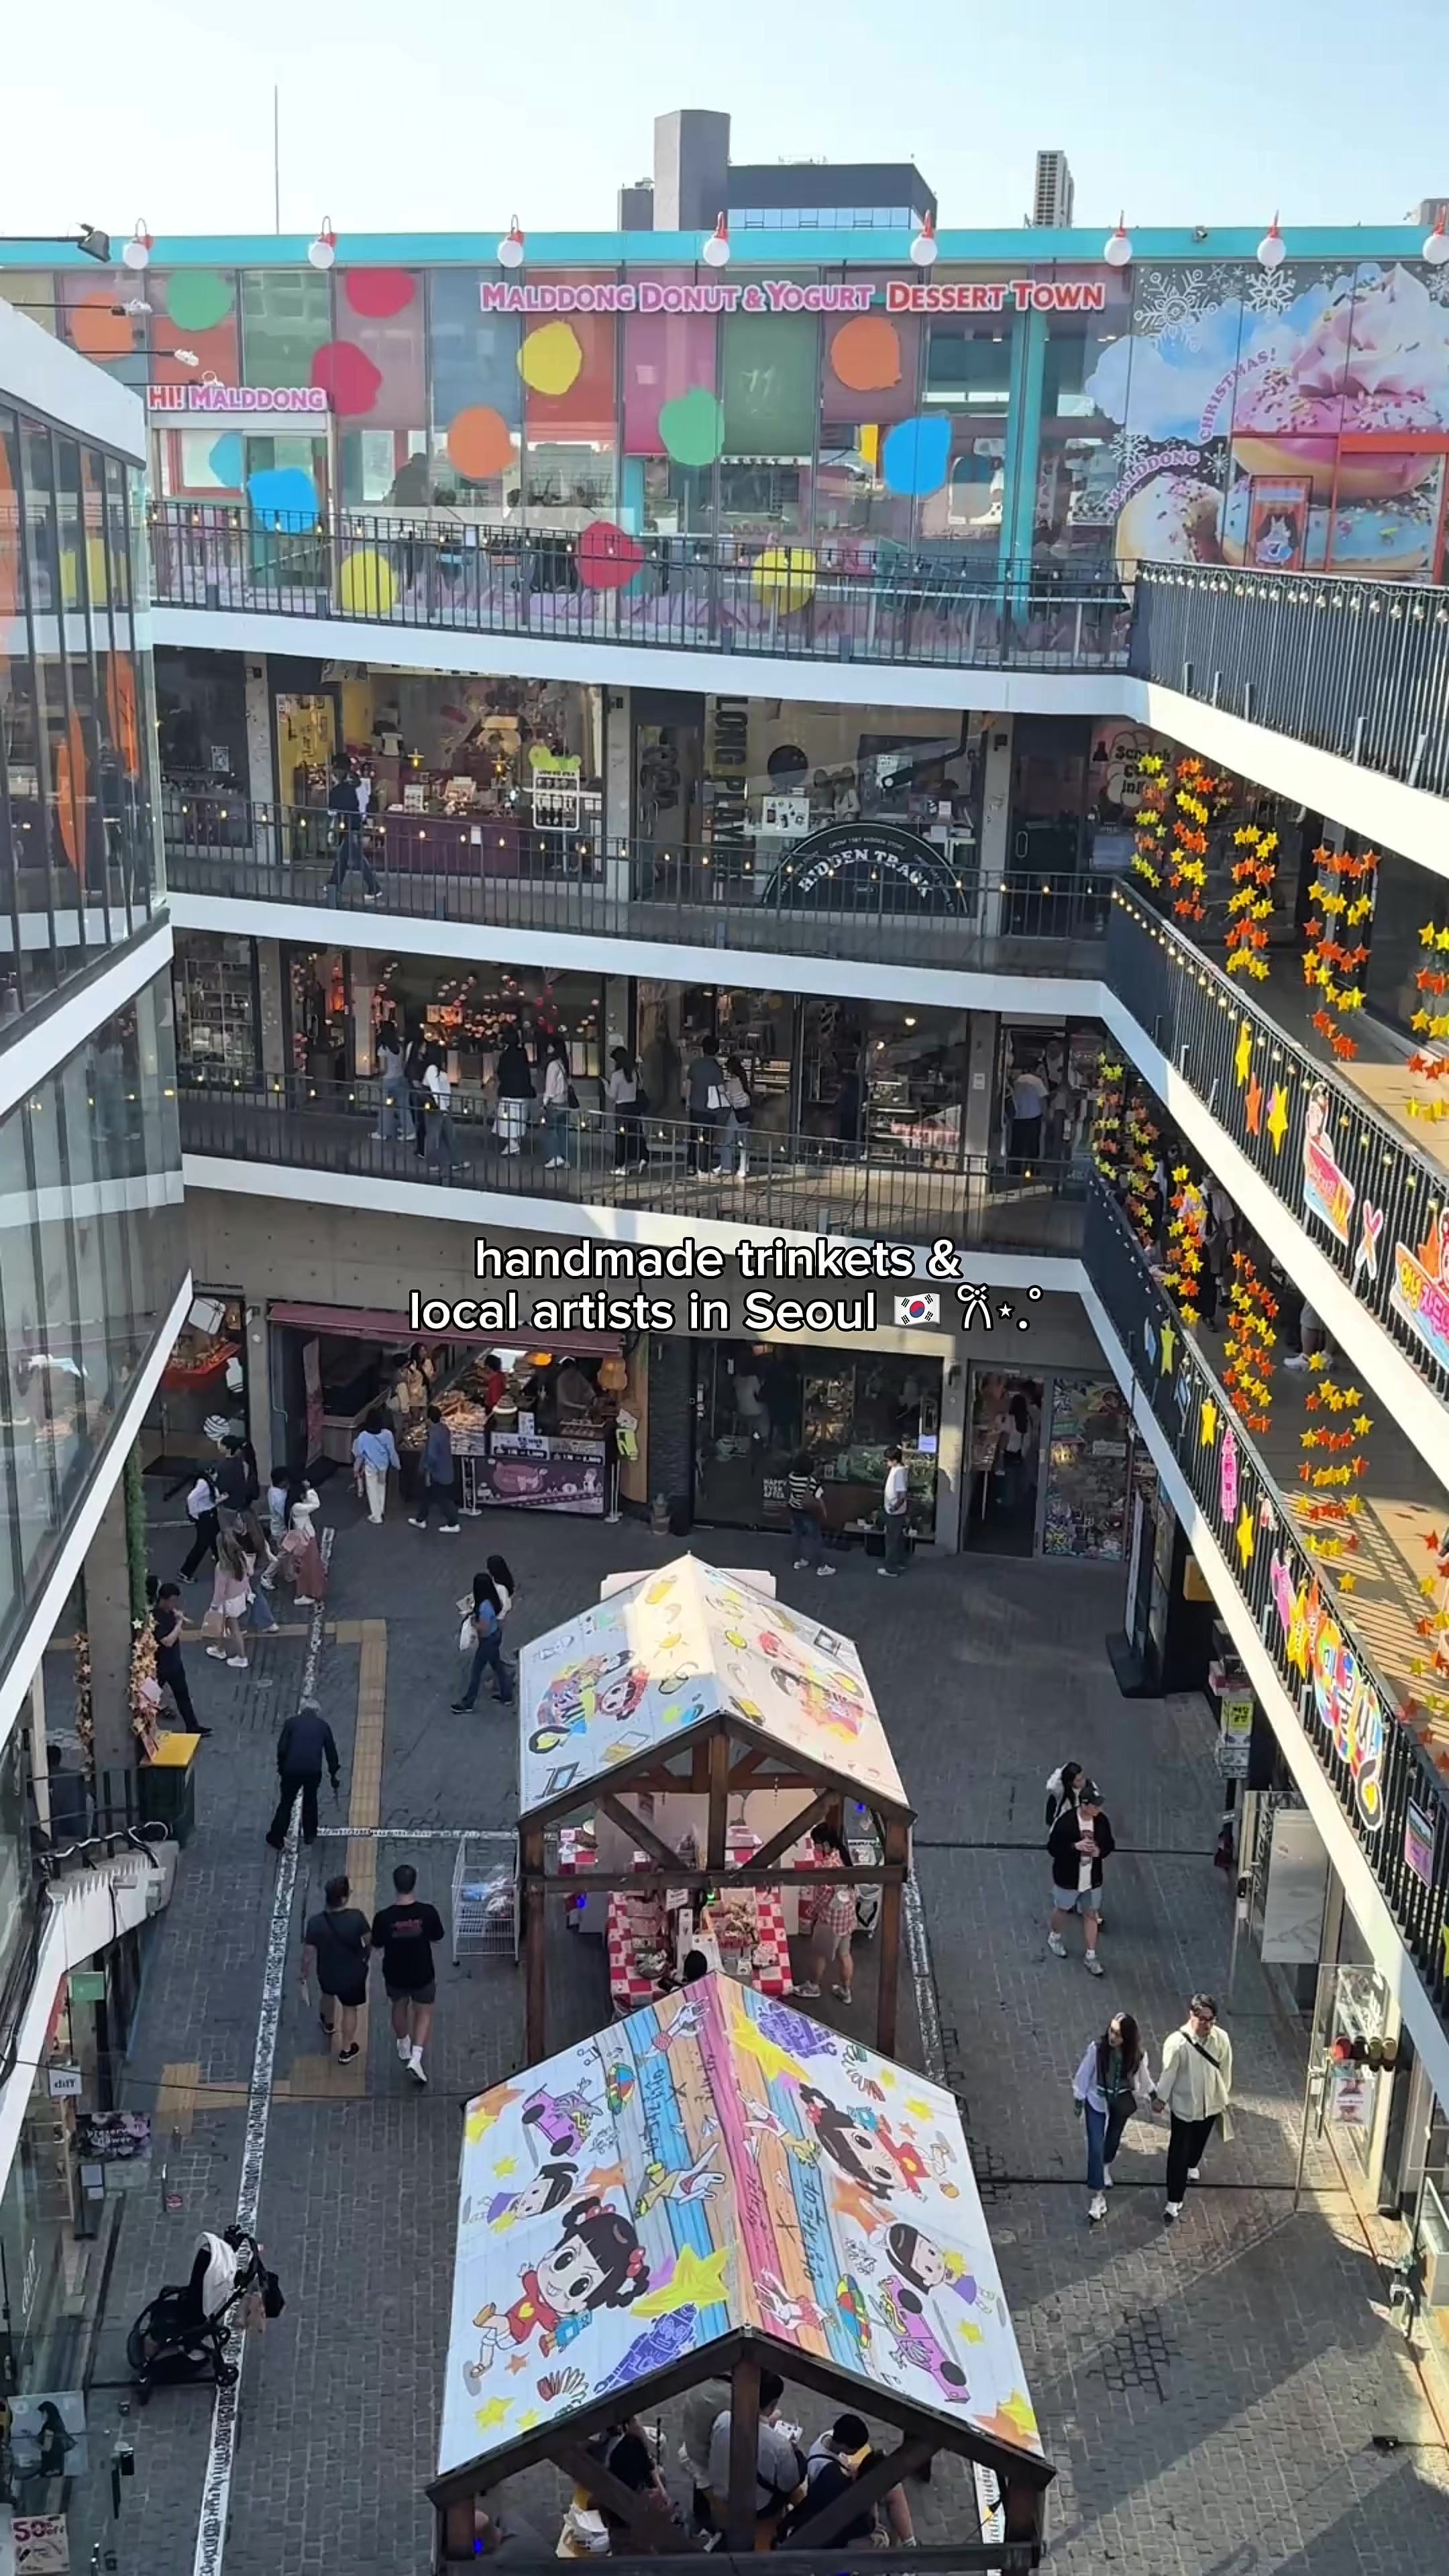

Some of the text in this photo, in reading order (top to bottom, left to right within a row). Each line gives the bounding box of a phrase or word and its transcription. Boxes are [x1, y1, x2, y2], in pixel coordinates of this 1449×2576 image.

[482, 280, 1104, 311] MALDDONG DONUT & YOGURT DESSERT TOWN
[148, 386, 326, 411] HI! MALDDONG
[713, 696, 749, 765] LONG
[1421, 1283, 1449, 1342] 자두
